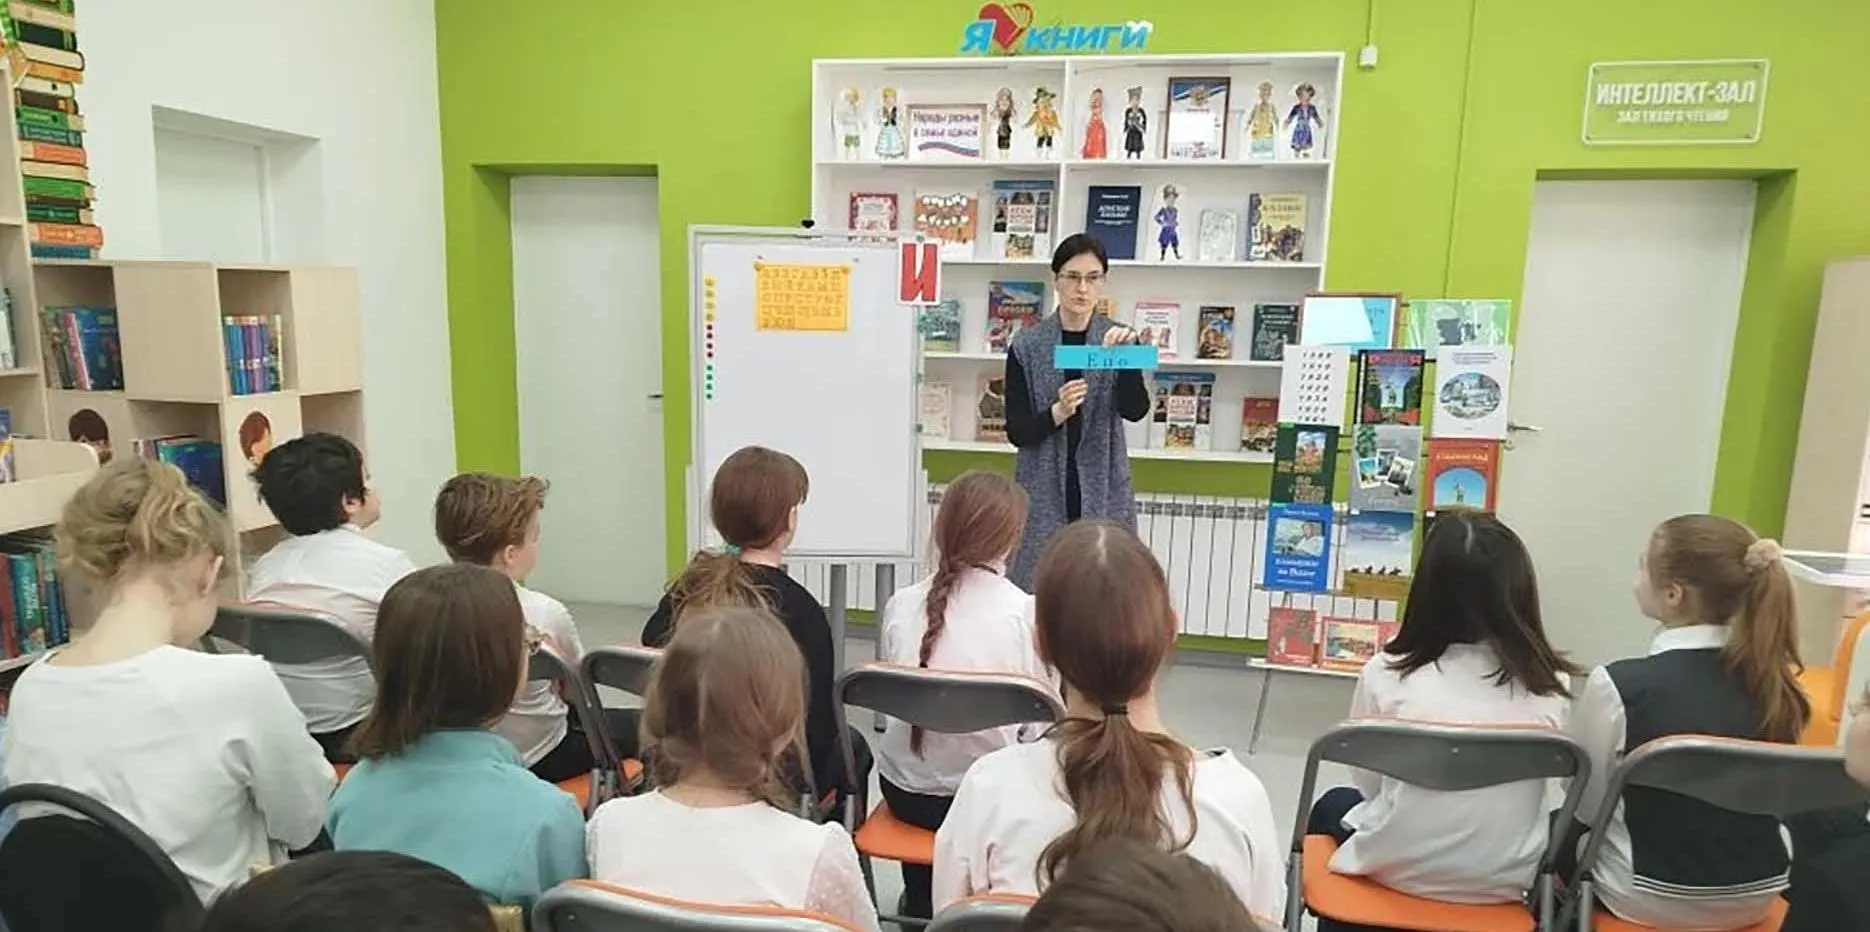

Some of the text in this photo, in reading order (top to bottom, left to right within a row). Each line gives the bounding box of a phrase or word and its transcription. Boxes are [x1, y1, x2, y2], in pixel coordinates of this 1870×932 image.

[960, 20, 992, 52] Я
[1595, 80, 1757, 105] ИНТЕЛЛЕКТ-ЗАЛ
[900, 243, 938, 302] И
